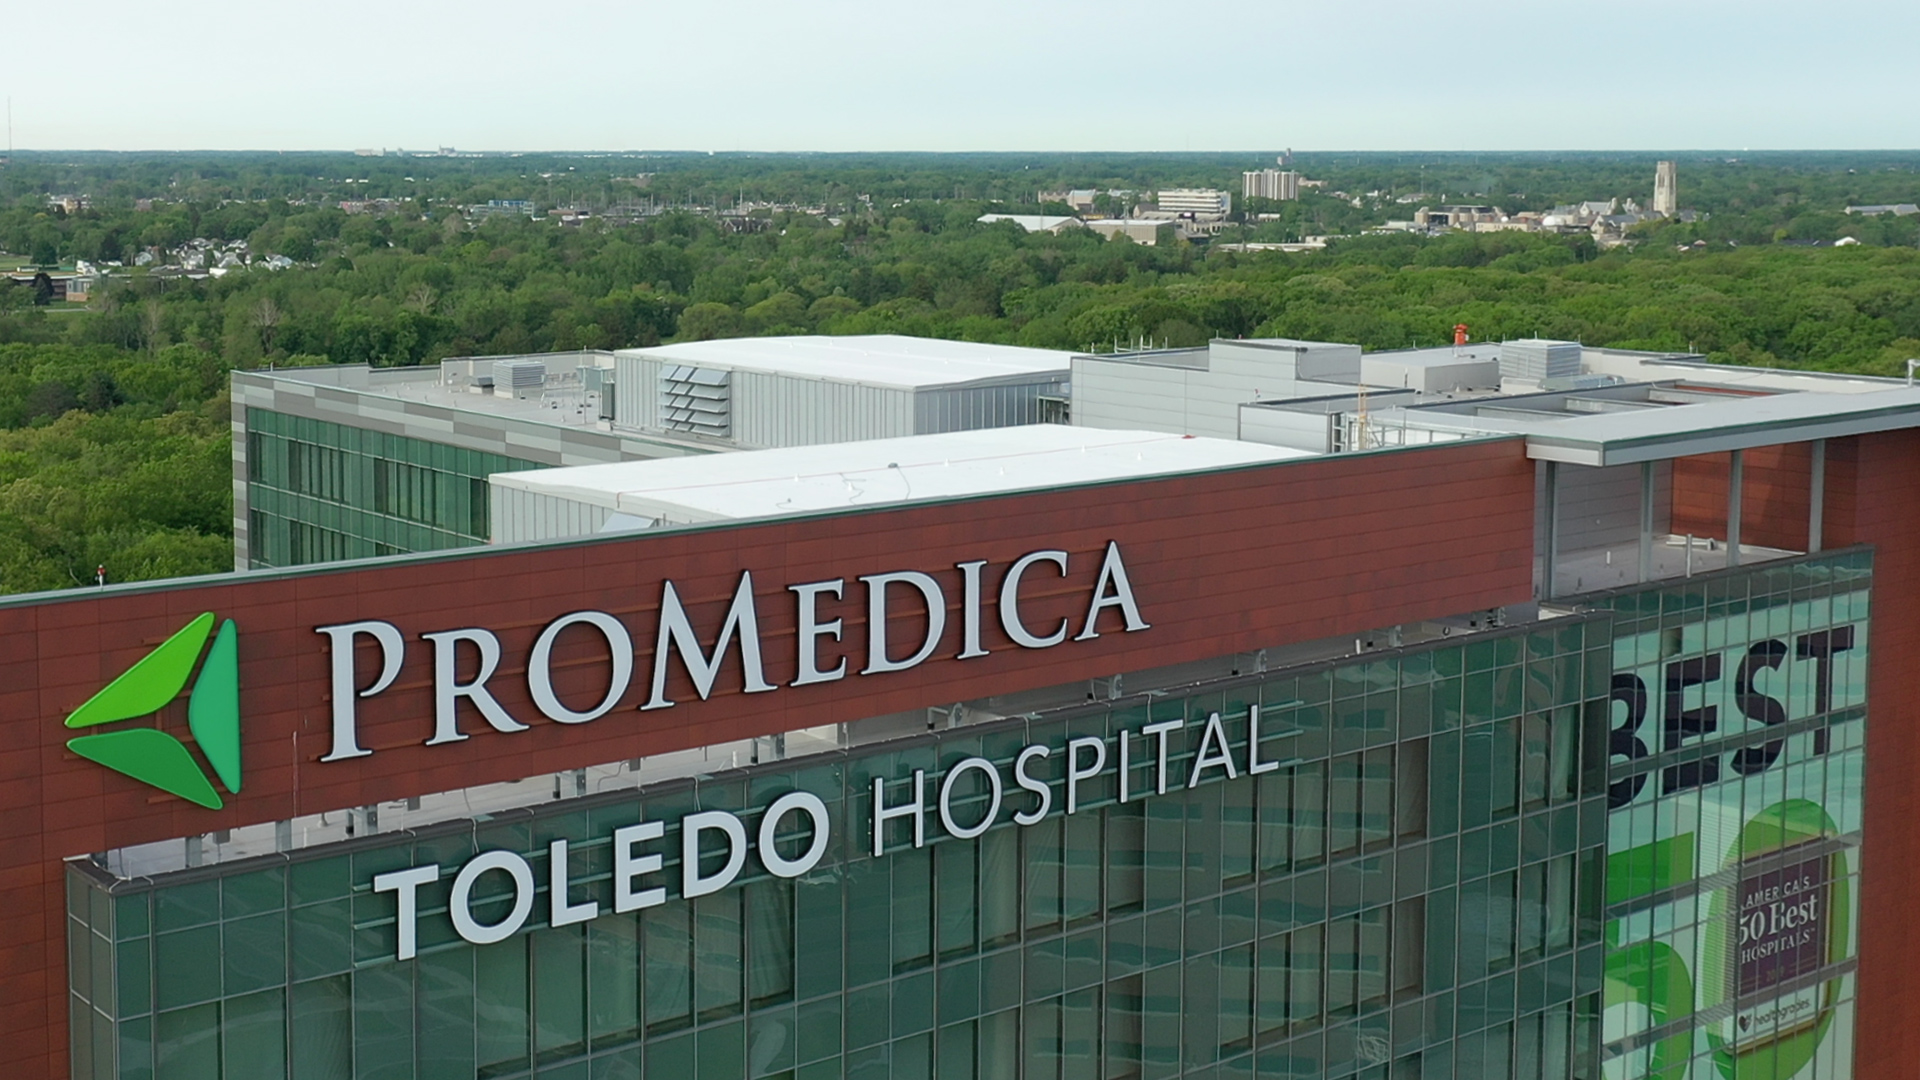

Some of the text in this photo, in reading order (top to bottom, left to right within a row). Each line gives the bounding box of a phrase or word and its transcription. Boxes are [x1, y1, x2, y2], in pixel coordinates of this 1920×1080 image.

[315, 541, 1151, 762] PROMEDICA
[1607, 624, 1855, 810] BEST
[374, 705, 1280, 960] TOLEDO HOSPITAL
[1739, 894, 1819, 946] 50 Best
